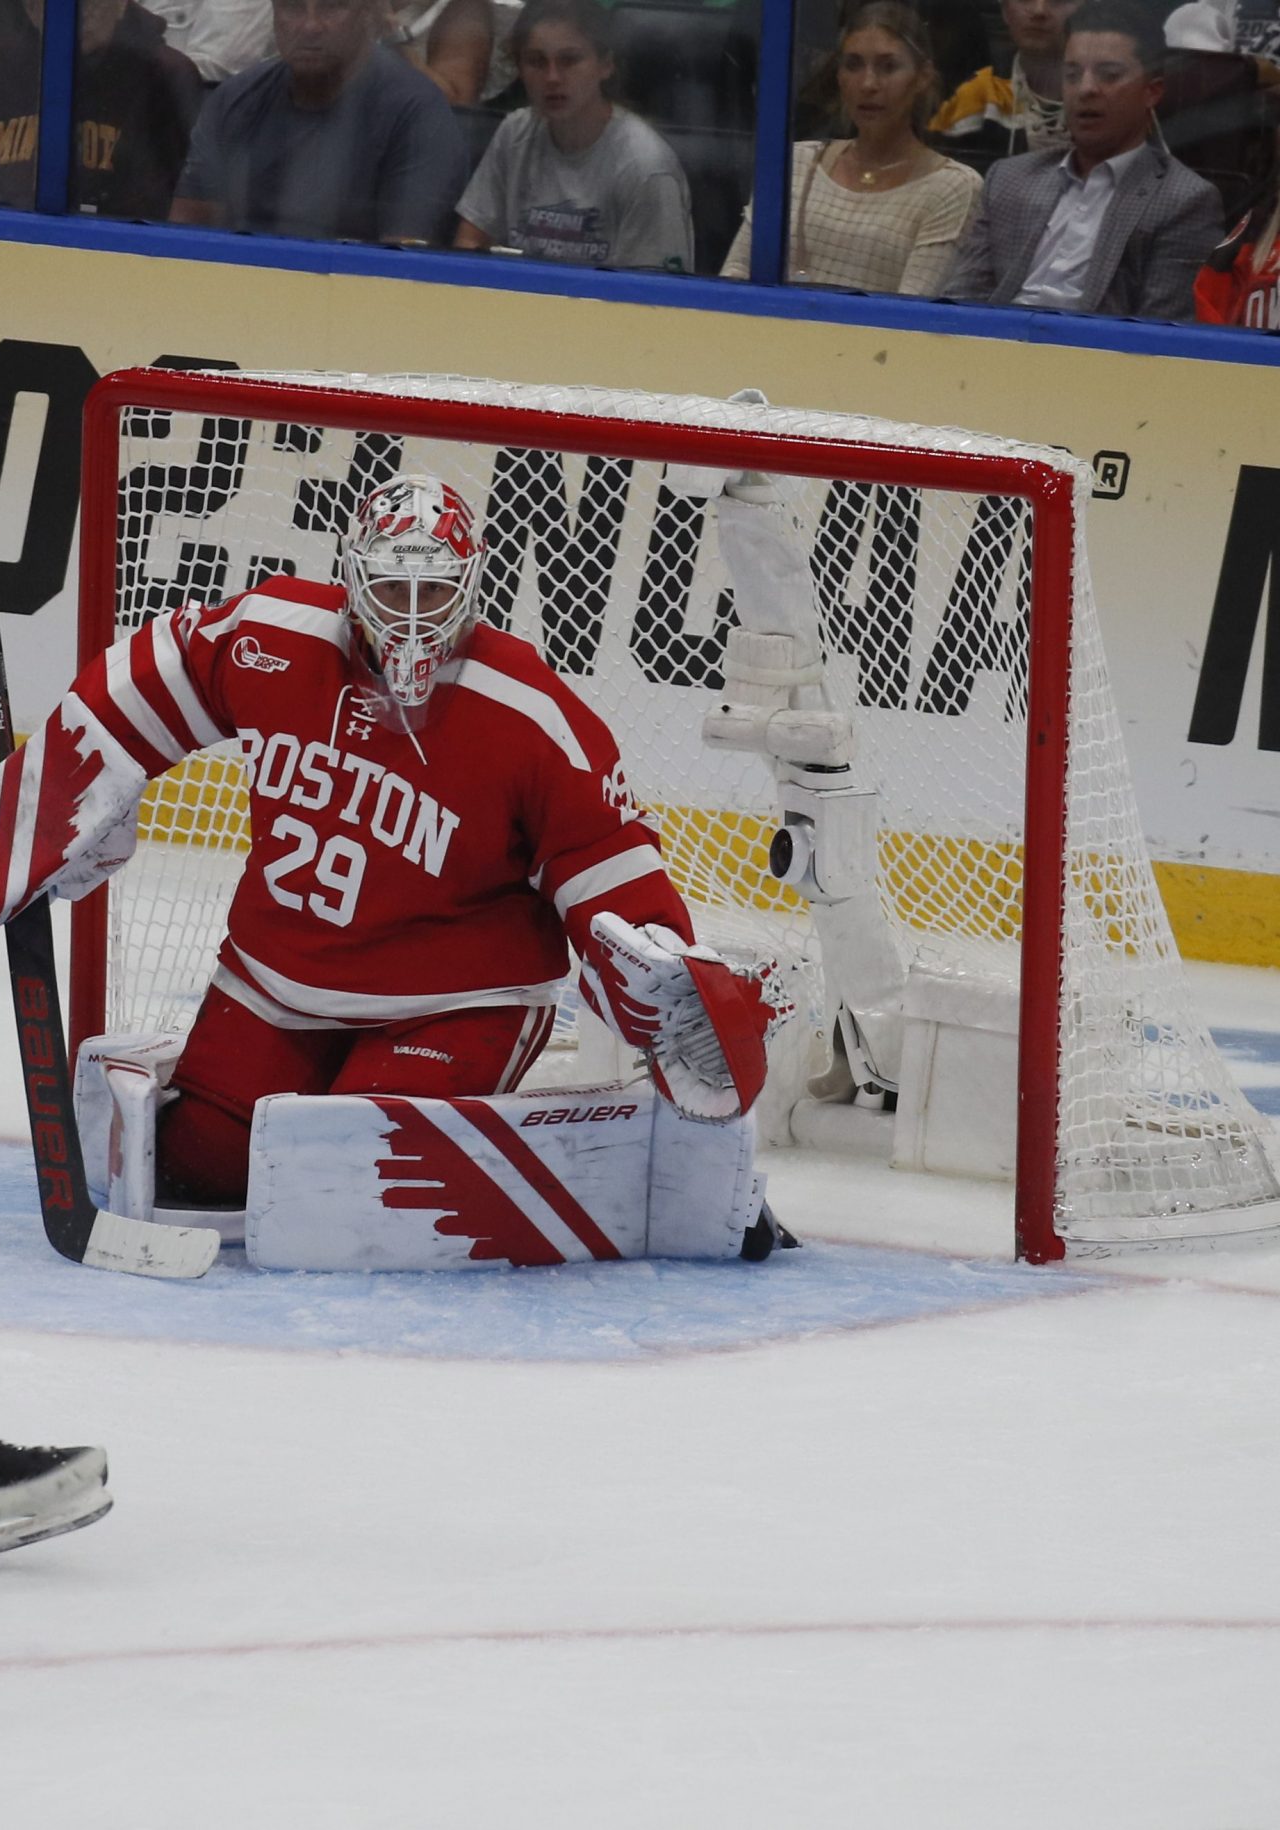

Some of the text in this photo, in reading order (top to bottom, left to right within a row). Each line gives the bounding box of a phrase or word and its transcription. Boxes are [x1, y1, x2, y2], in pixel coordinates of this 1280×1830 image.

[236, 727, 461, 879] BOSTON
[263, 813, 368, 928] 29
[594, 930, 652, 974] BAUER
[17, 975, 74, 1213] BAUER
[392, 1045, 454, 1065] VAUGHN
[519, 1104, 638, 1128] BAUER
